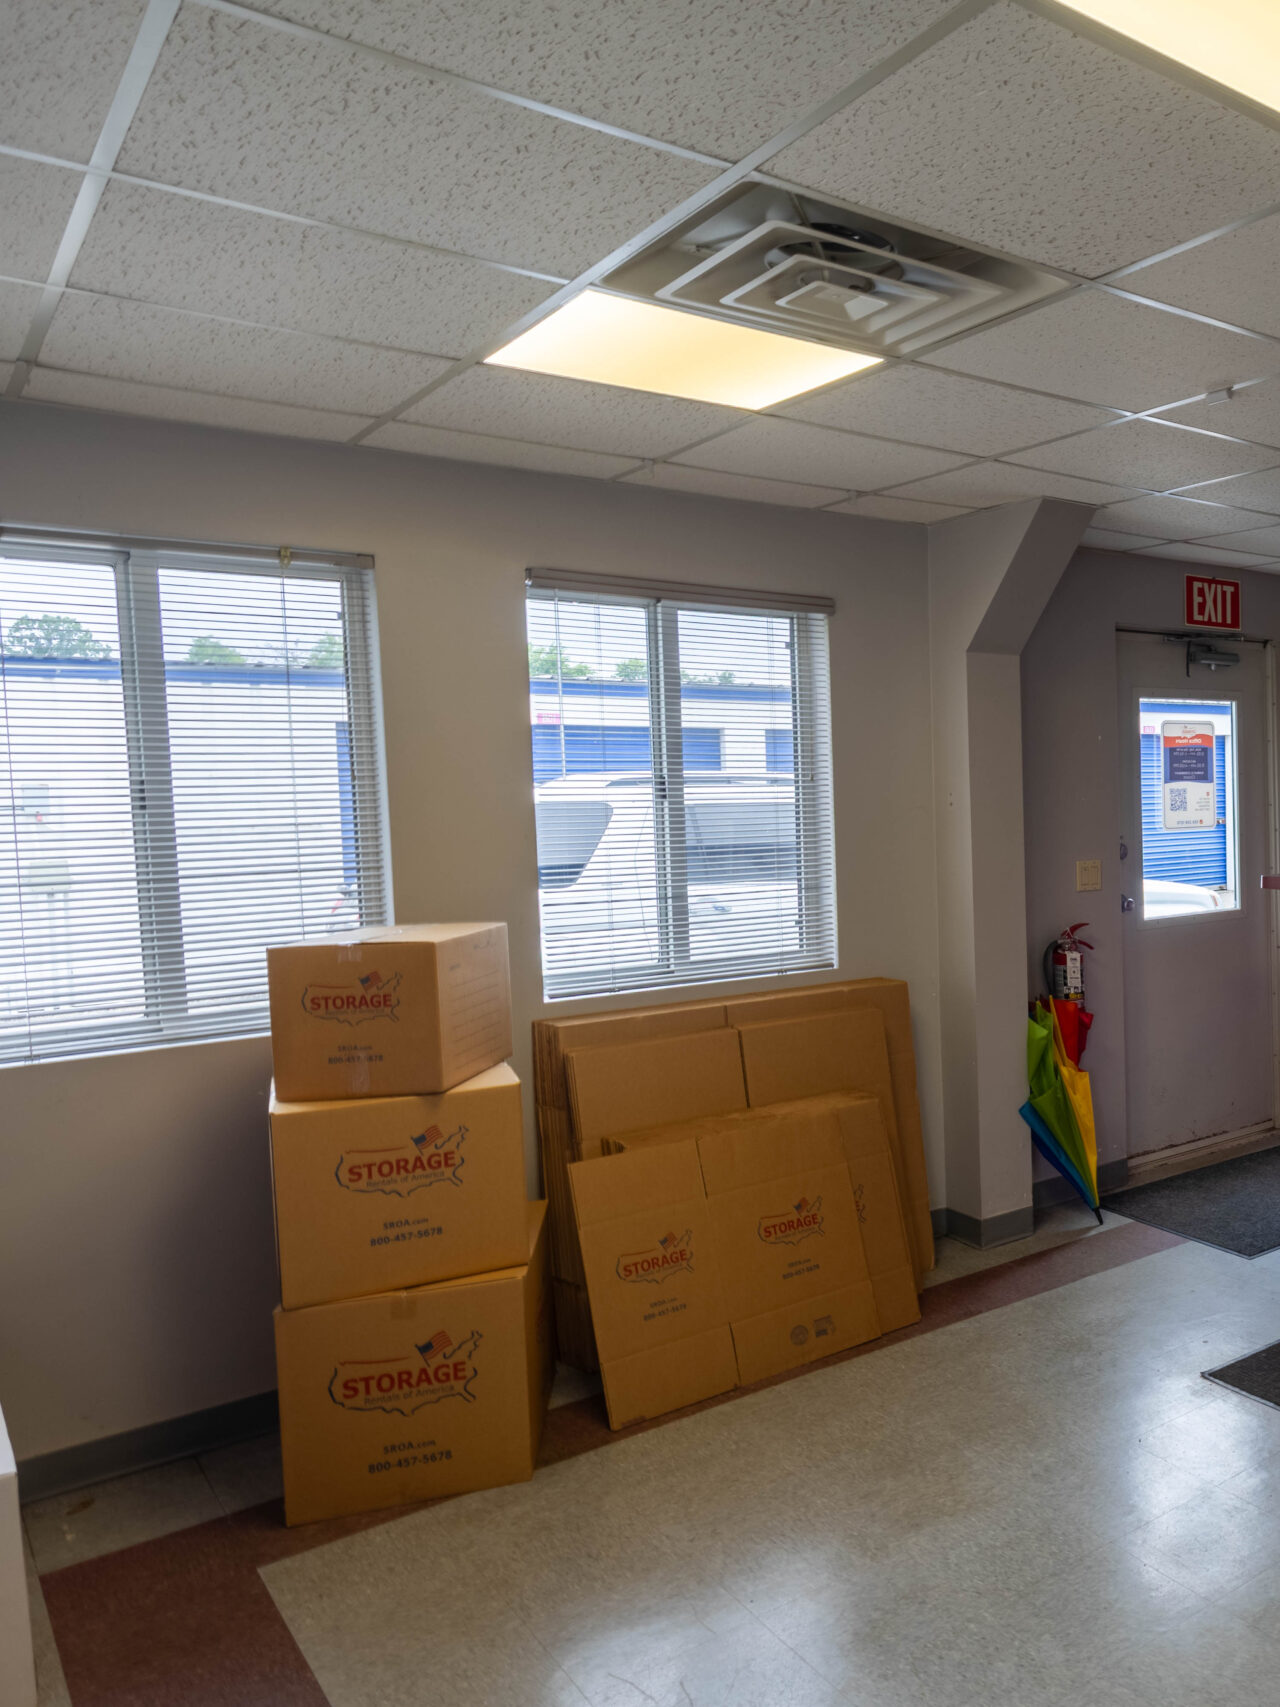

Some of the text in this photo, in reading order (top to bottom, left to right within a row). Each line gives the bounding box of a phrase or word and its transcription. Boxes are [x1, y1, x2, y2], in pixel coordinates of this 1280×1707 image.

[1192, 581, 1235, 625] EXIT
[309, 994, 392, 1011] STORAGE
[347, 1151, 456, 1184] STORAGE
[366, 1170, 445, 1188] Rentals of America
[383, 1217, 429, 1231] SROA.com
[763, 1213, 819, 1238] STORAGE
[370, 1225, 443, 1248] 800-457-5678
[623, 1249, 688, 1277] STORAGE
[341, 1361, 468, 1400] STORAGE
[364, 1384, 455, 1405] Rentals of America
[383, 1439, 436, 1455] SROA.com
[367, 1449, 453, 1475] 800-457-5678
